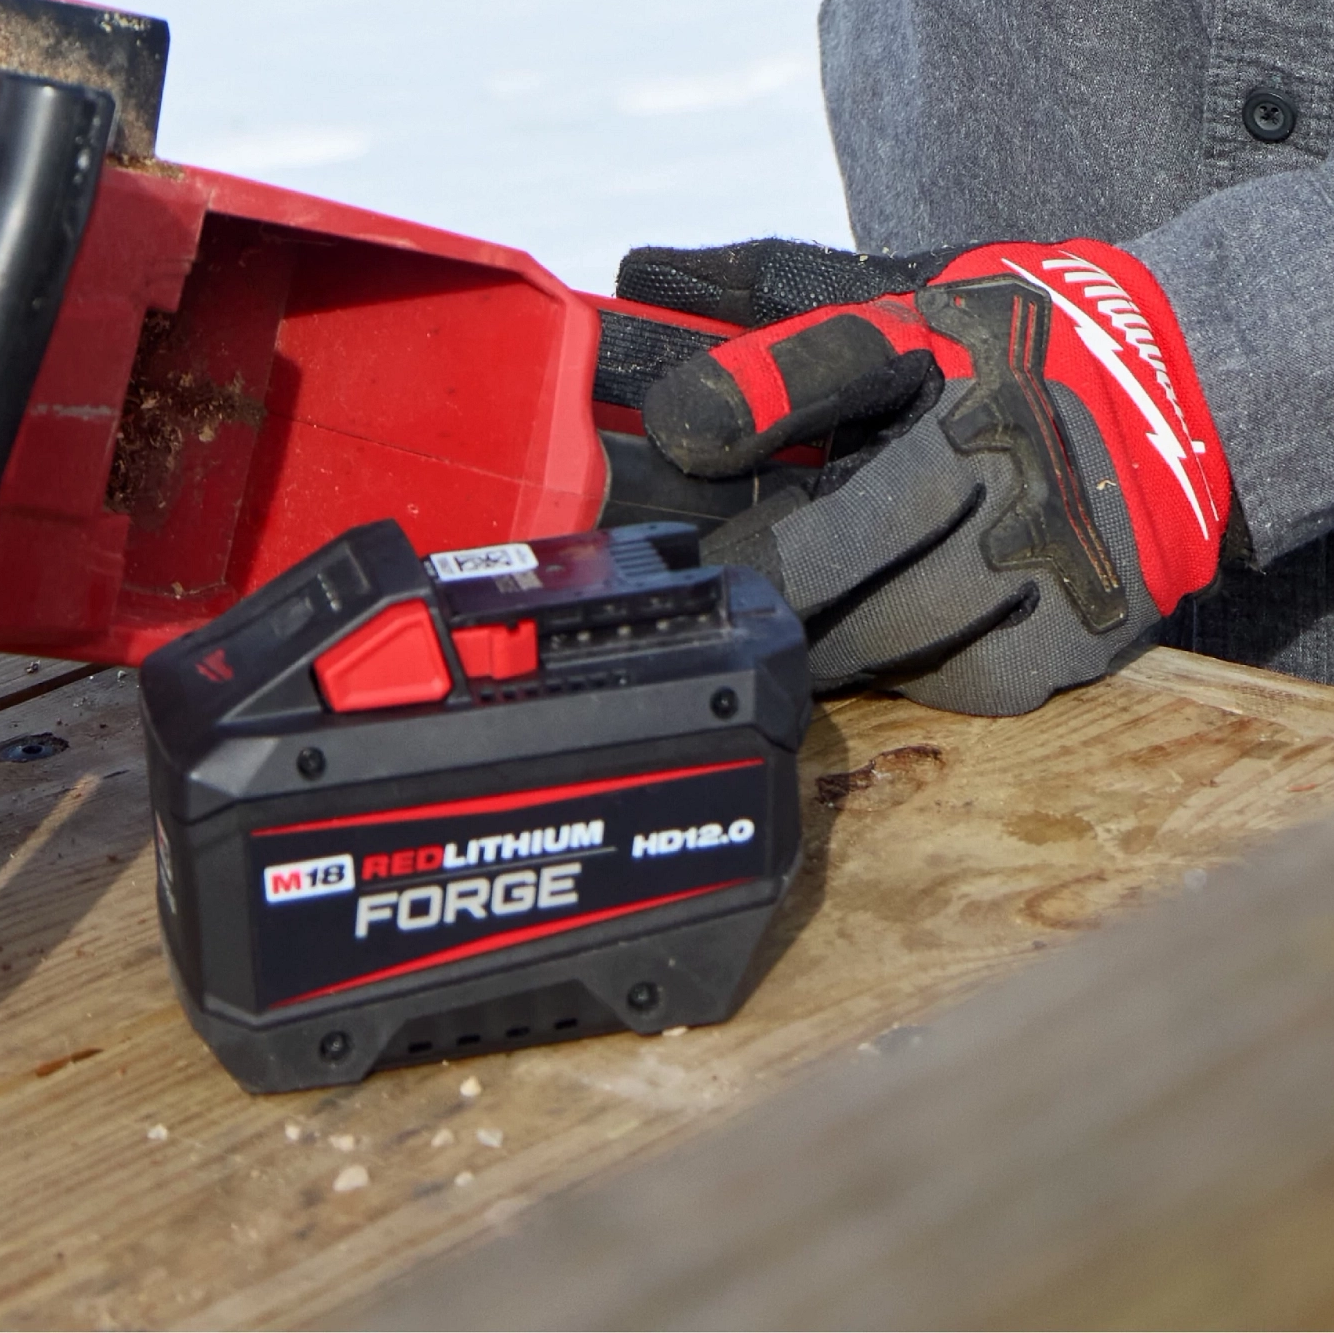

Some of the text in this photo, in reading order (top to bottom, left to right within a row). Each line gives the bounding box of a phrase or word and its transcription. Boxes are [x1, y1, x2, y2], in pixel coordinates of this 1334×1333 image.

[632, 819, 755, 858] HD12.0
[272, 865, 346, 895] M18
[355, 863, 583, 939] FORGE
